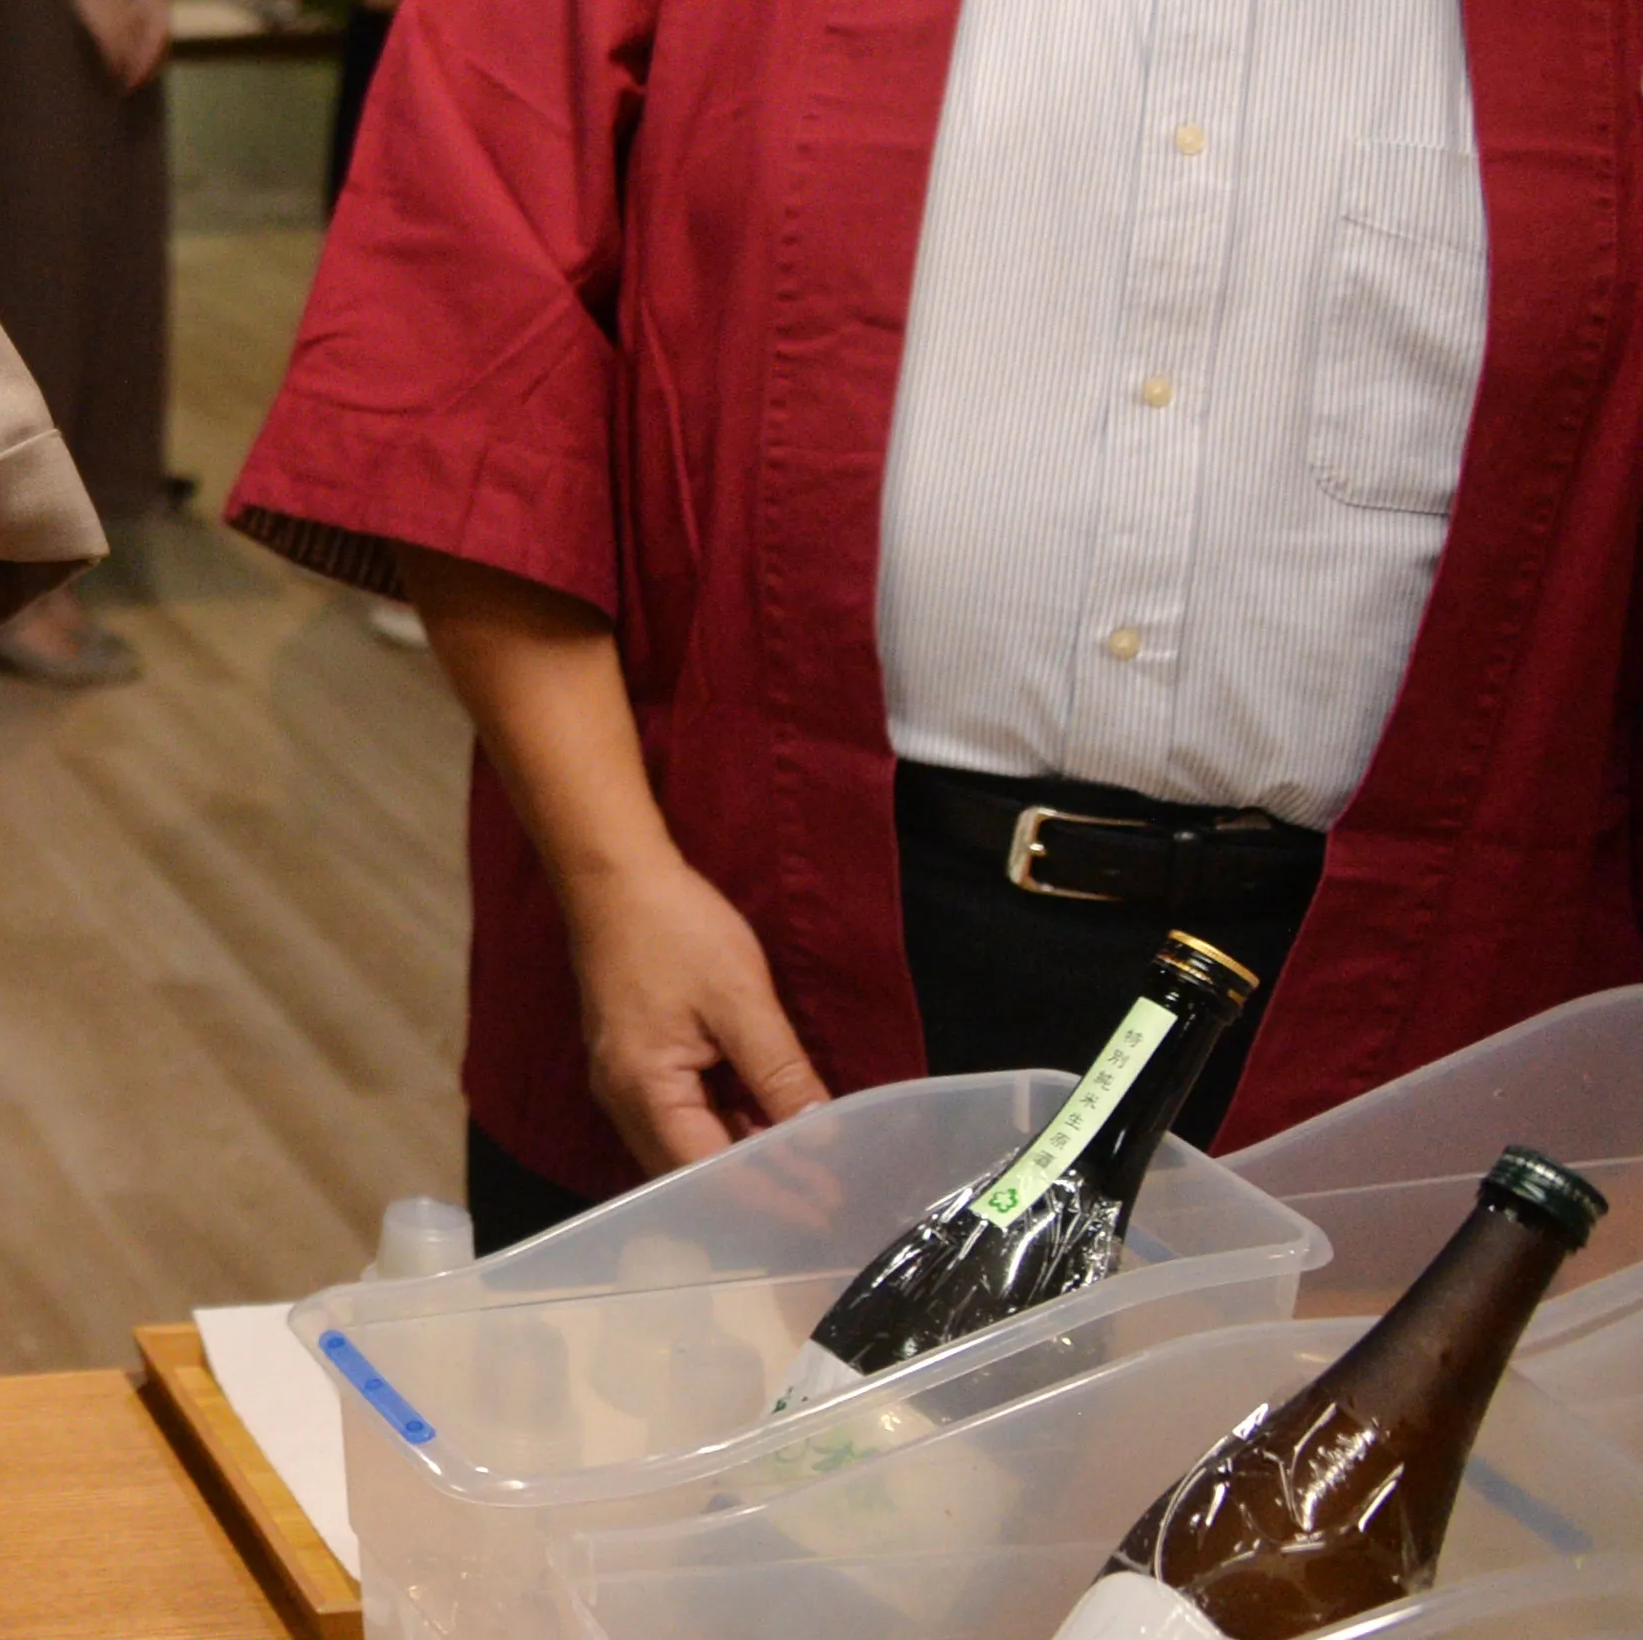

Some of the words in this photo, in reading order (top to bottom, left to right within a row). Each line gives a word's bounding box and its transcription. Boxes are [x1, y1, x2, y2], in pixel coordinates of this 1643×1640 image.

[1032, 1028, 1144, 1169] 特別純米生原酒
